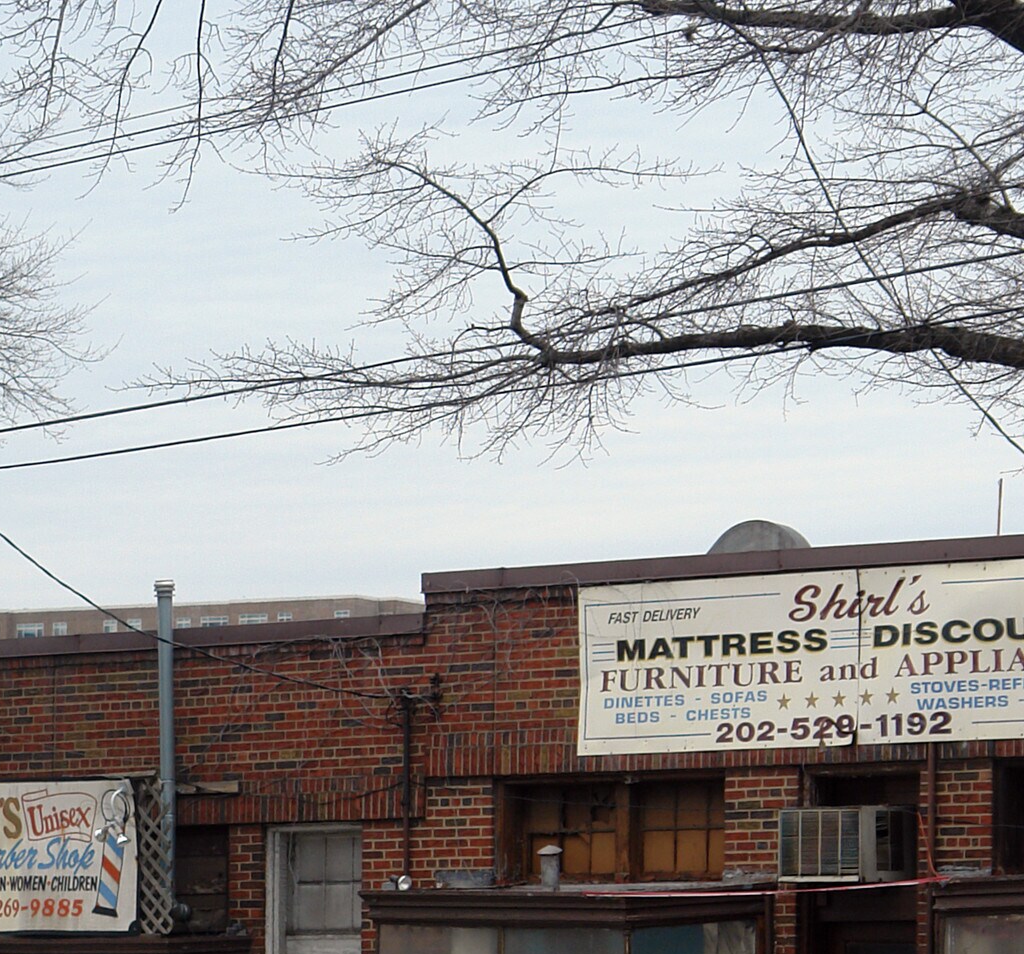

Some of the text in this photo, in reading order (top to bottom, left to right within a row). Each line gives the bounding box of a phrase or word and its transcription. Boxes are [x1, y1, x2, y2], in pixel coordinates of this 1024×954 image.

[789, 575, 930, 622] Shirl's
[608, 606, 701, 625] FAST DELIVERY
[616, 628, 829, 662] MATTRESS
[599, 659, 804, 693] FURNITURE
[819, 657, 879, 683] and
[604, 693, 685, 709] DINETTES
[710, 689, 768, 704] SOFAS
[615, 710, 660, 724] BEDS
[686, 706, 751, 722] CHESTS
[916, 695, 1009, 711] WASHERS
[715, 711, 953, 743] 202-529-1192
[27, 804, 92, 837] Unisex
[38, 837, 96, 874] Shop
